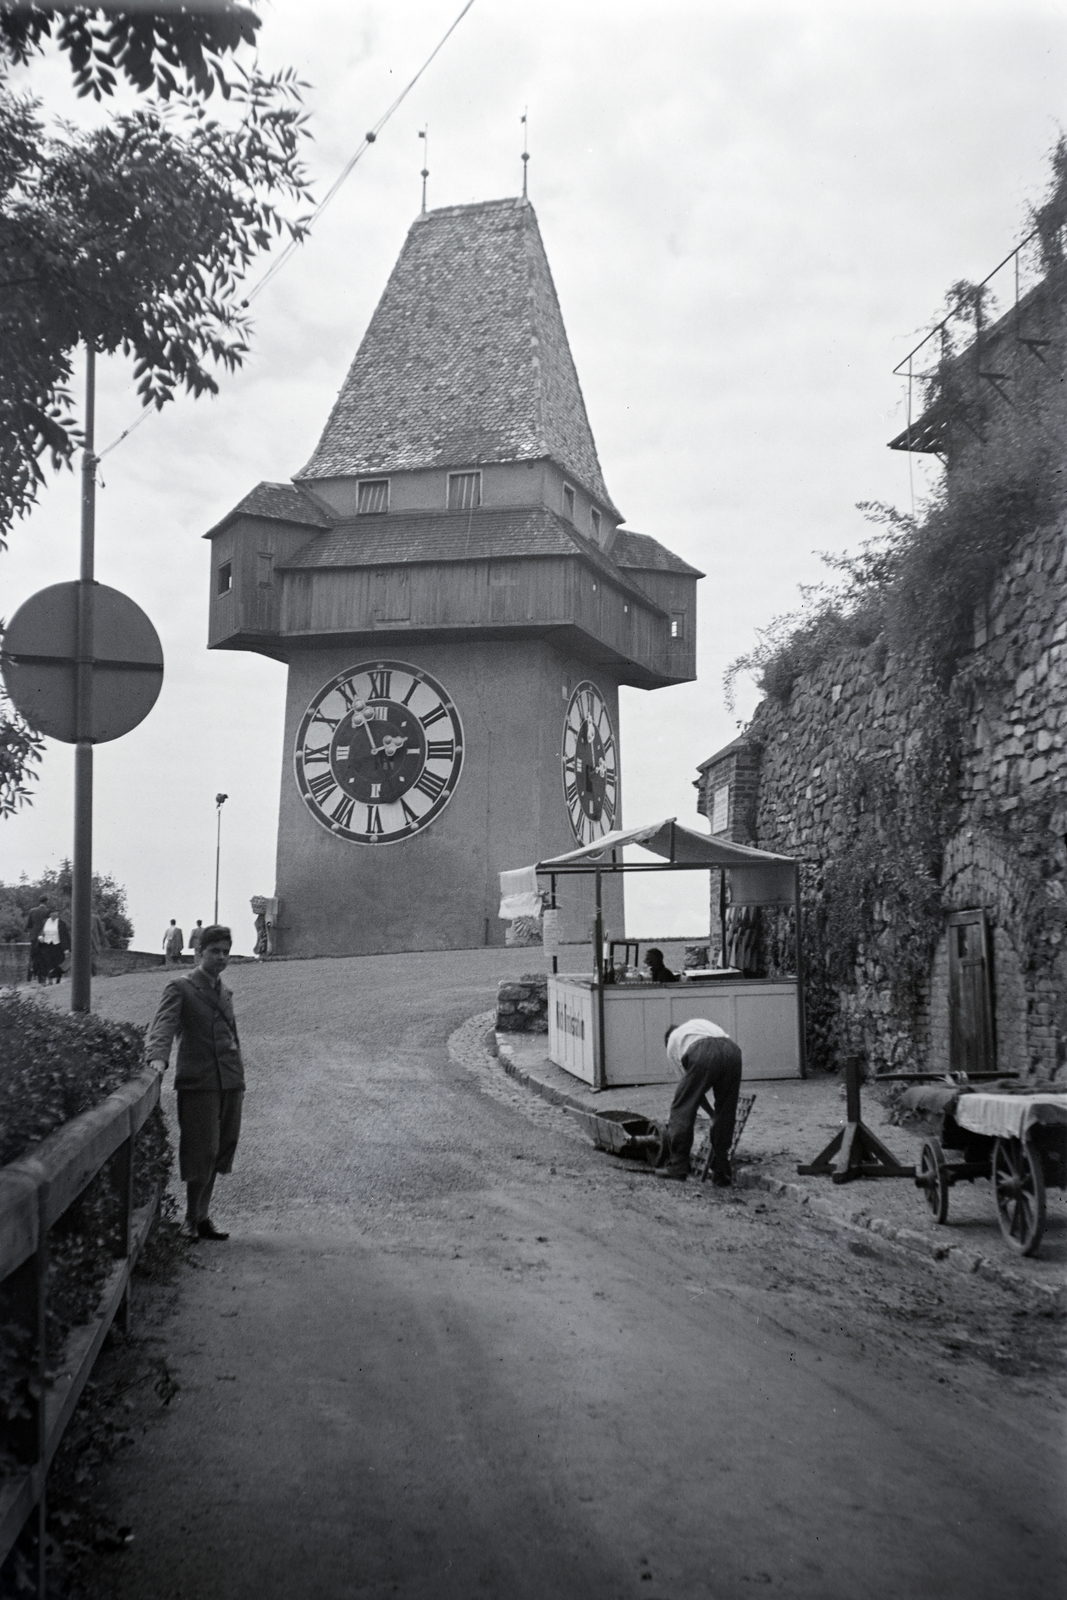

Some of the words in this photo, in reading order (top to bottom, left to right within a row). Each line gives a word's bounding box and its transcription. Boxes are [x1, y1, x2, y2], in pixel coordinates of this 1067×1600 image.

[367, 671, 392, 700] XII
[401, 678, 421, 706] I
[312, 708, 340, 733] X
[419, 702, 448, 730] II
[305, 743, 330, 765] IX
[427, 739, 454, 762] III
[307, 769, 338, 807] VIII
[413, 766, 448, 803] IIII
[329, 794, 355, 829] VII
[365, 804, 384, 833] VI
[400, 797, 420, 826] V
